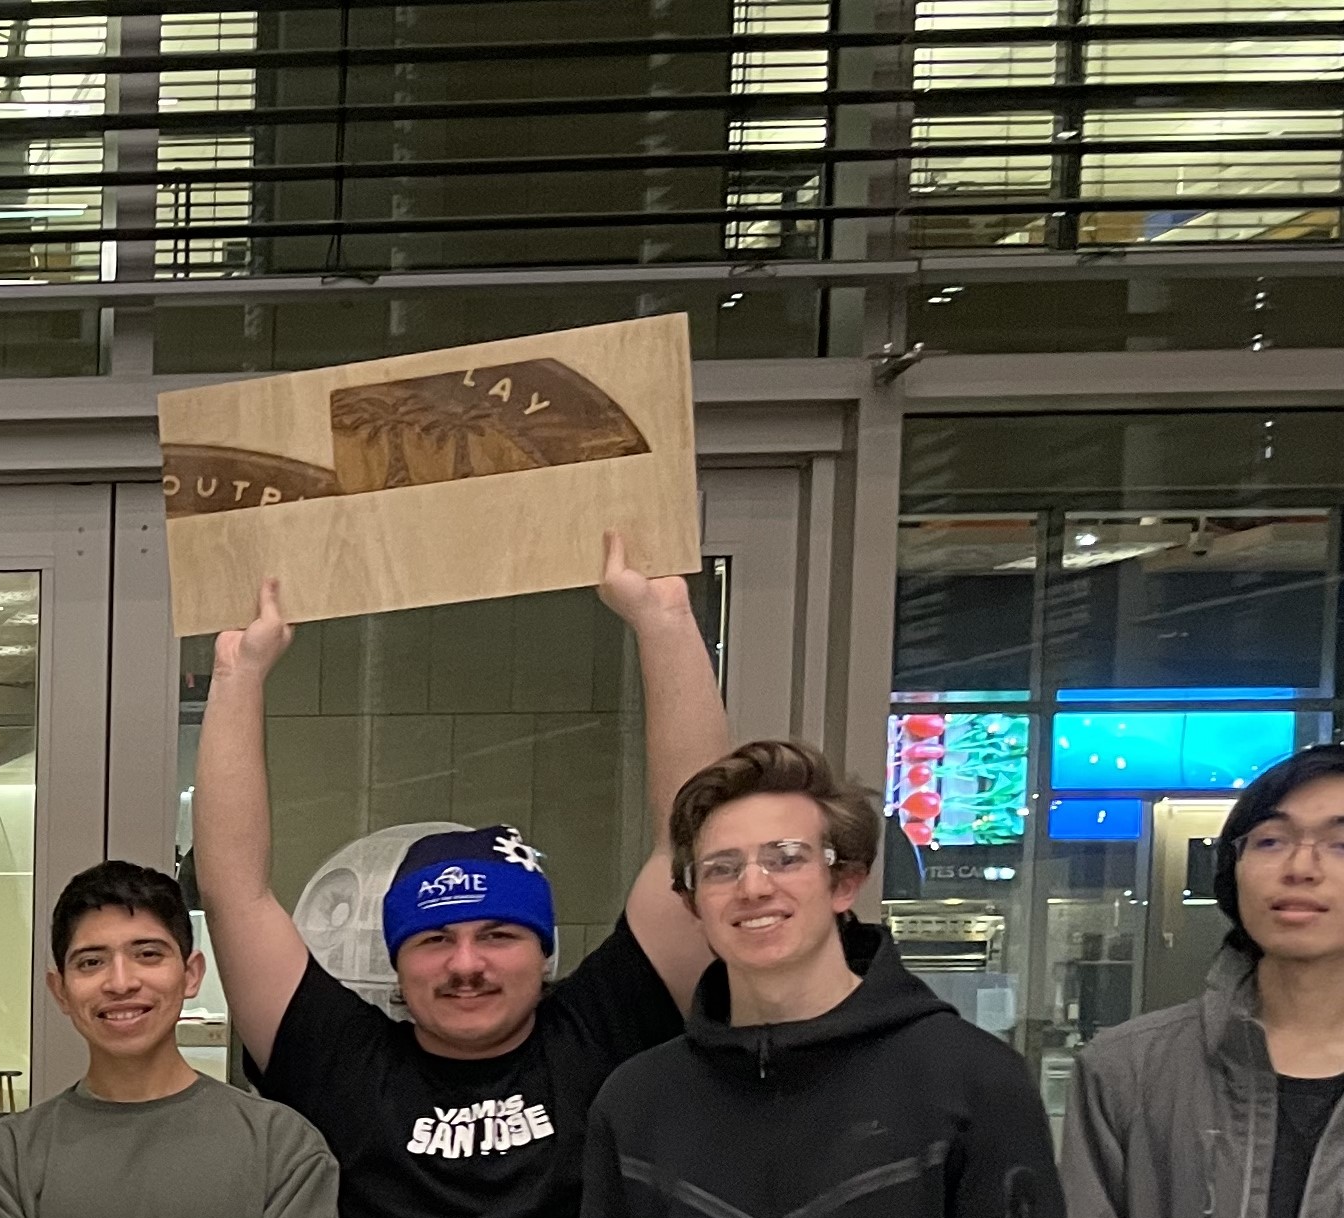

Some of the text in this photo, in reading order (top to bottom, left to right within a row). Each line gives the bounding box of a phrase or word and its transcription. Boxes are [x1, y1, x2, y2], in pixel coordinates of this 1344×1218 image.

[162, 475, 304, 507] OUTP
[418, 872, 488, 898] ASME
[433, 1094, 525, 1125] VAMOS
[407, 1104, 555, 1159] SAN JOSE
